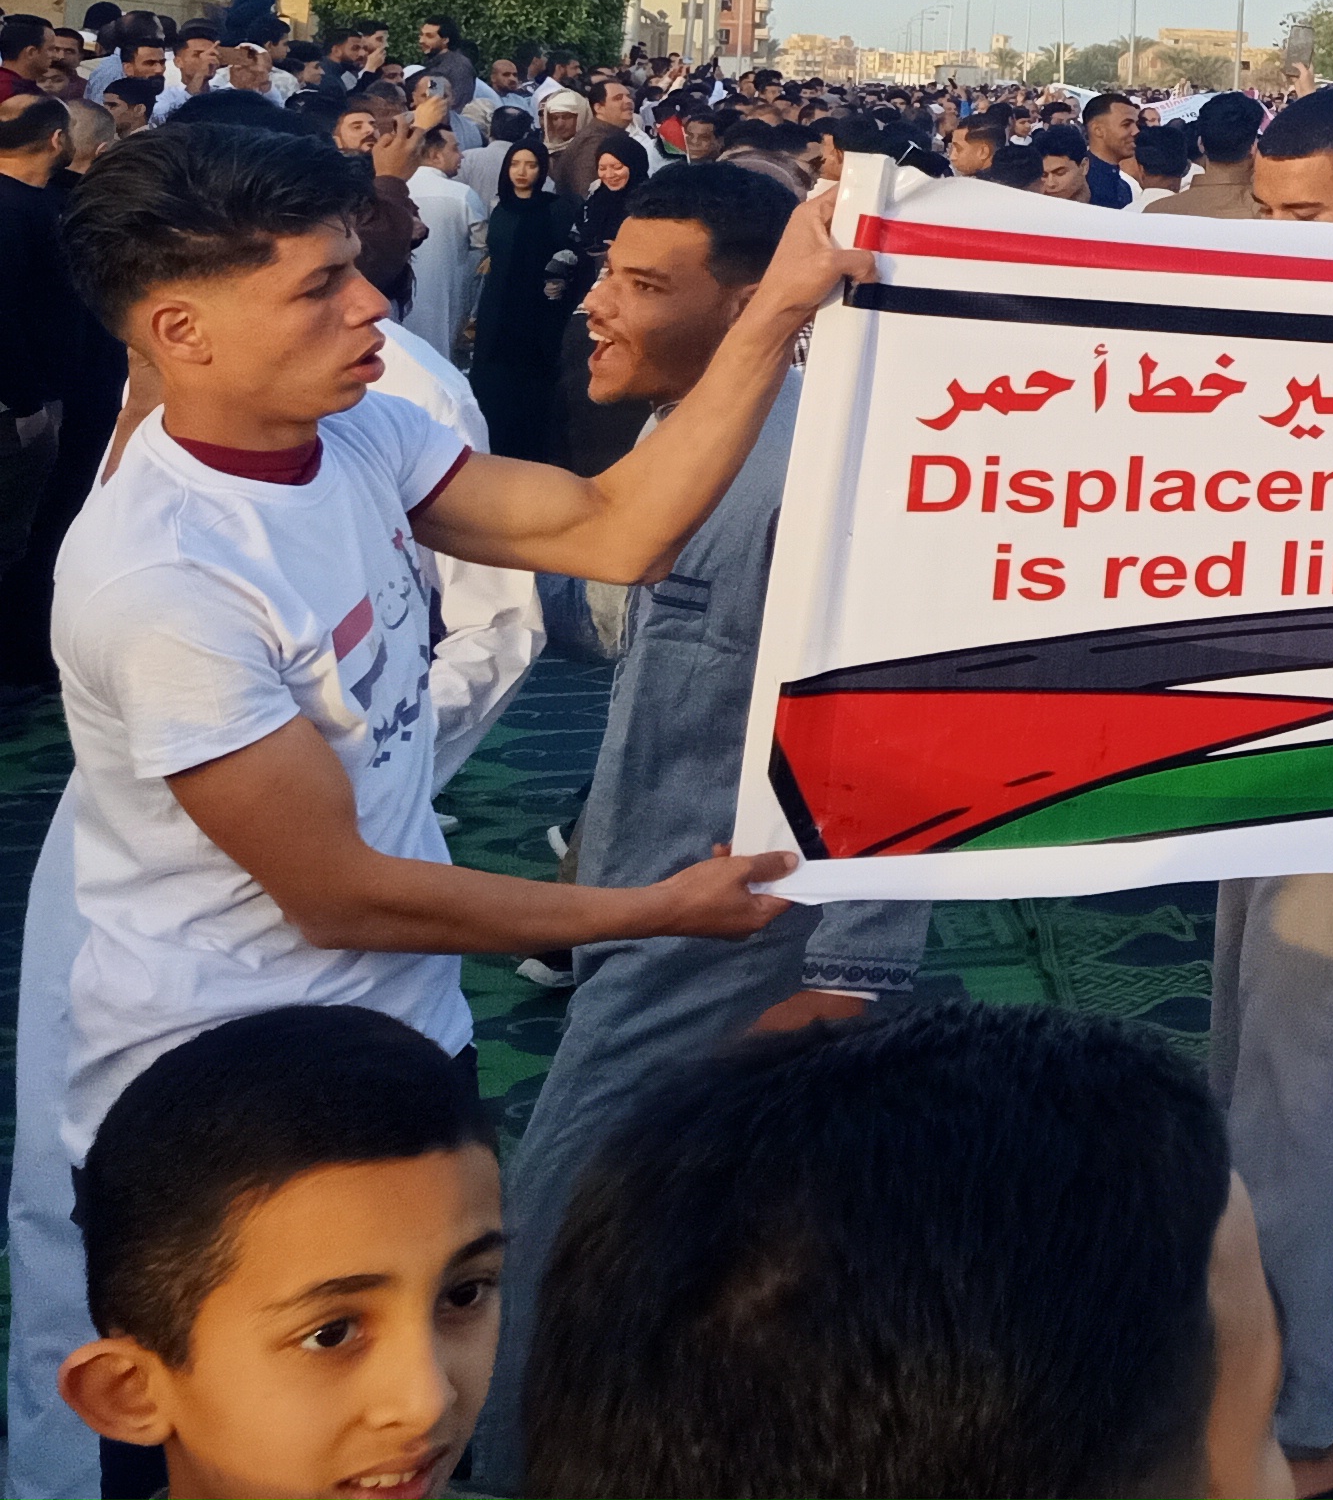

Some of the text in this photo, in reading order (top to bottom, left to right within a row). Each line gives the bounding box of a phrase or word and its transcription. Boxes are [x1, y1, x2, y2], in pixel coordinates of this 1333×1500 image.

[917, 343, 1109, 432] أحمر
[1128, 351, 1248, 414] خط
[991, 542, 1068, 602] is
[1102, 539, 1249, 600] red
